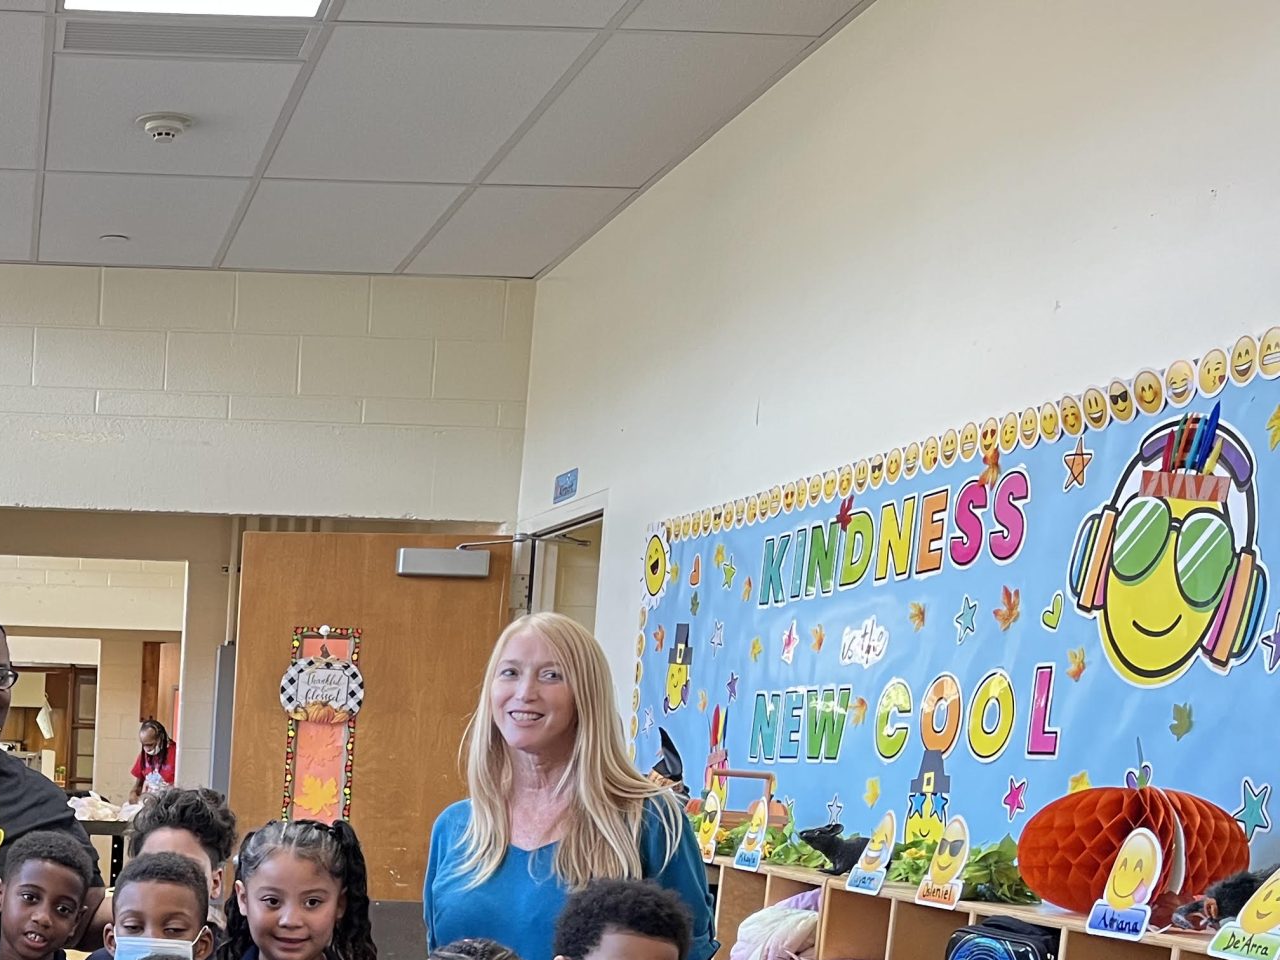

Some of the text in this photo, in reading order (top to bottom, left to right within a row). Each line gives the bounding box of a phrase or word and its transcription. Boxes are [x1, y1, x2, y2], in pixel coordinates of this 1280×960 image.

[759, 471, 1029, 605] KINDNESS
[749, 665, 1058, 760] NEW COOL
[1222, 931, 1269, 956] De'Arra
